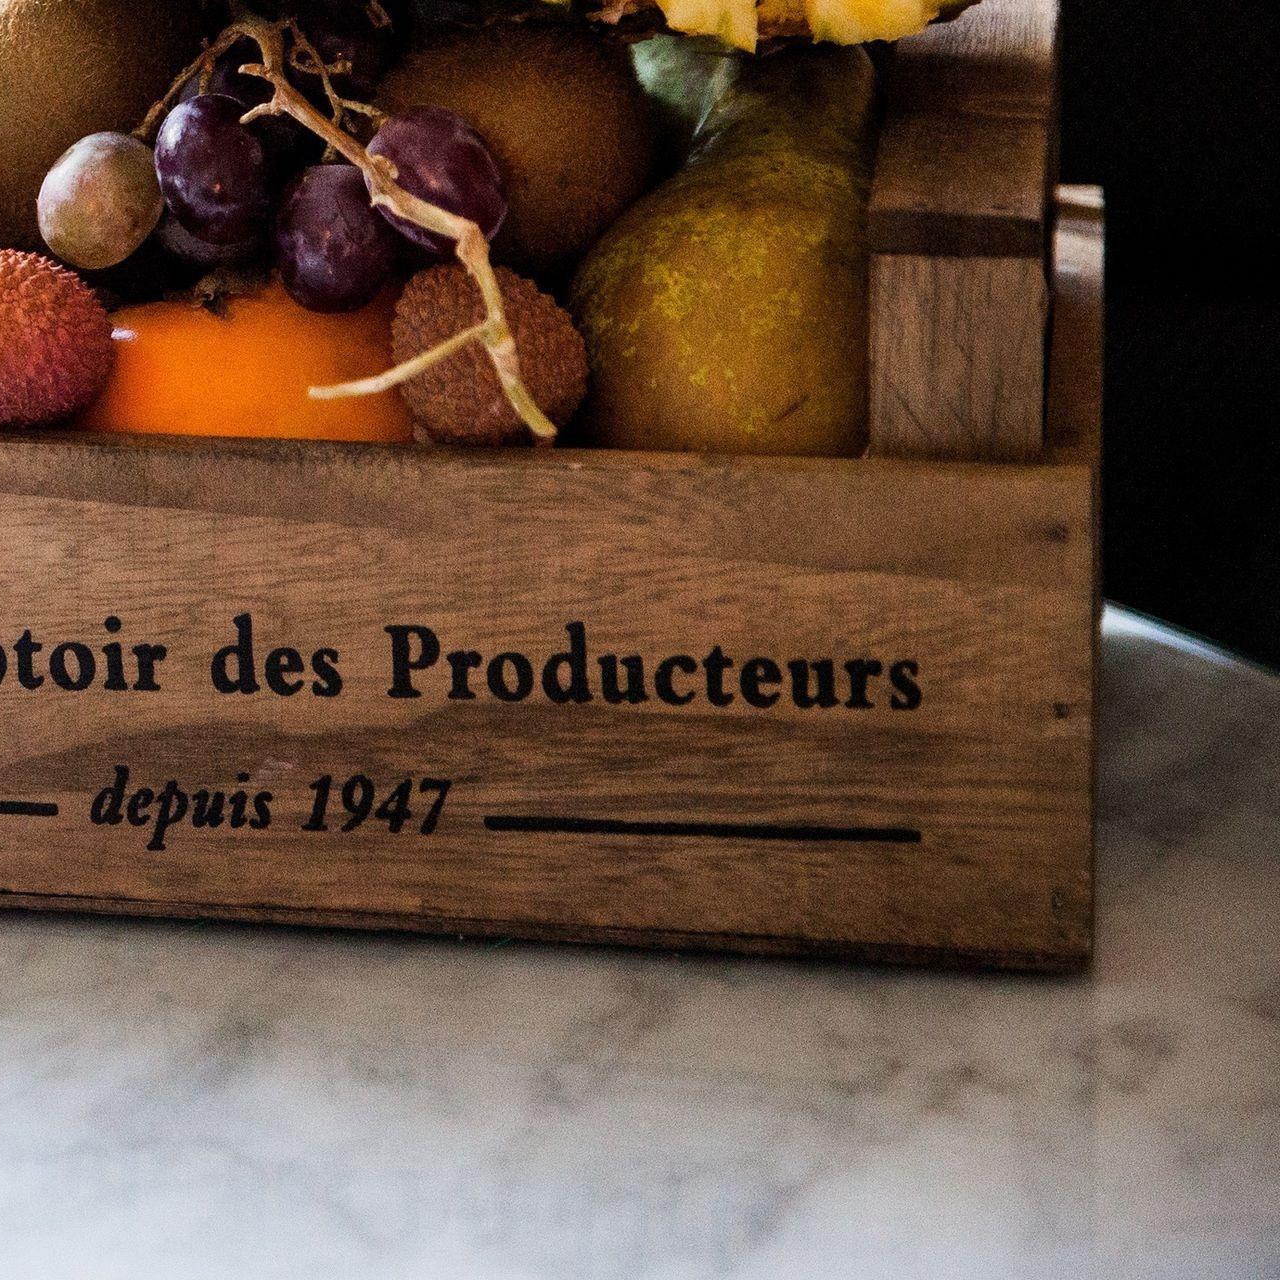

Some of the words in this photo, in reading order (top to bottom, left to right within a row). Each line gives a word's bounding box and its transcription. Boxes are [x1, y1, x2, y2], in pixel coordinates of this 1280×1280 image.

[209, 613, 341, 698] des
[383, 620, 922, 711] Producteurs
[89, 765, 274, 852] depuis
[300, 773, 453, 835] 1947
